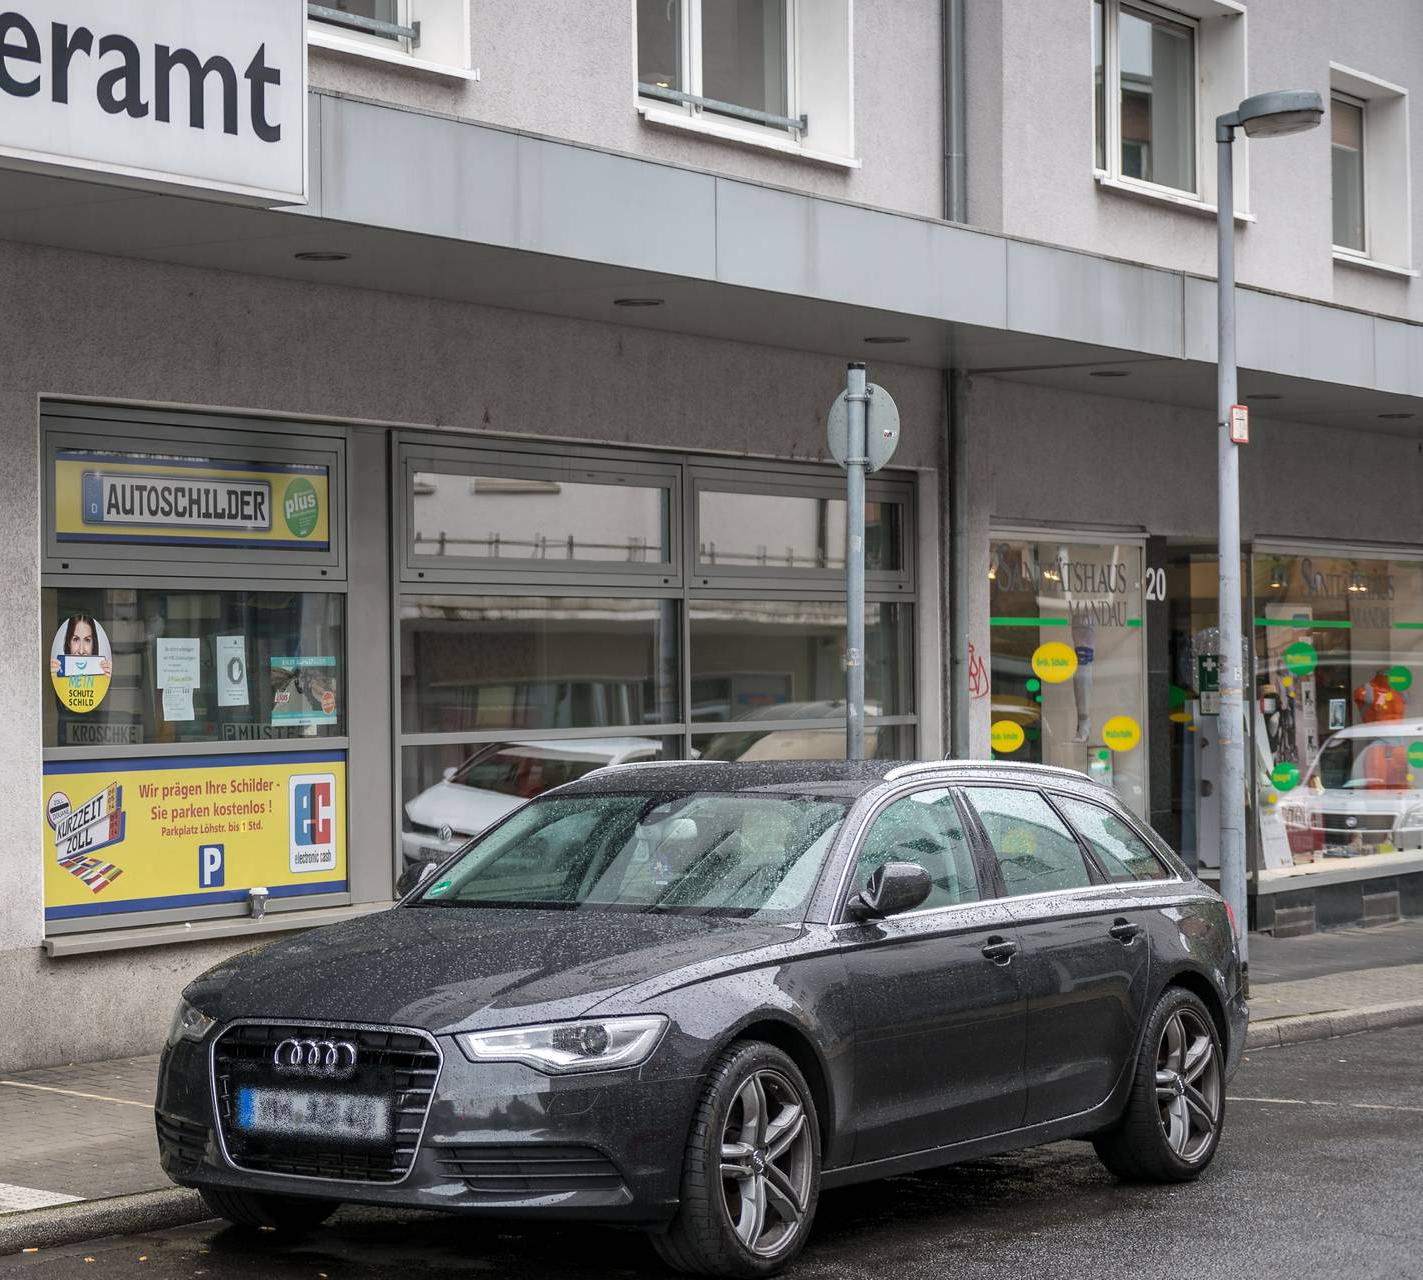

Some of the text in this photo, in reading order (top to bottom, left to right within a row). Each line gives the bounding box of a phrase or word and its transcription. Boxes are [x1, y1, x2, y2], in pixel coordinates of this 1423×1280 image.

[107, 483, 266, 522] AUTOSCHILDER
[286, 493, 316, 520] plus
[1145, 567, 1167, 602] 20
[1068, 600, 1127, 627] MANDAU
[69, 689, 94, 698] SCHUTZ
[69, 698, 94, 707] SCHILD
[73, 724, 137, 744] KROSCHKE
[138, 783, 160, 800] Wir
[162, 780, 202, 802] prägen
[205, 780, 228, 796] Ihre
[230, 777, 274, 794] Schilder
[57, 794, 104, 840] KURZZEIT
[151, 806, 168, 821] Sie
[171, 804, 211, 822] parken
[213, 801, 266, 818] kostenlos
[66, 828, 93, 854] ZOLL
[161, 820, 264, 838] Parkplatz Löhstr. bis 1 Std.
[203, 847, 222, 885] P
[295, 849, 332, 865] electronic cash
